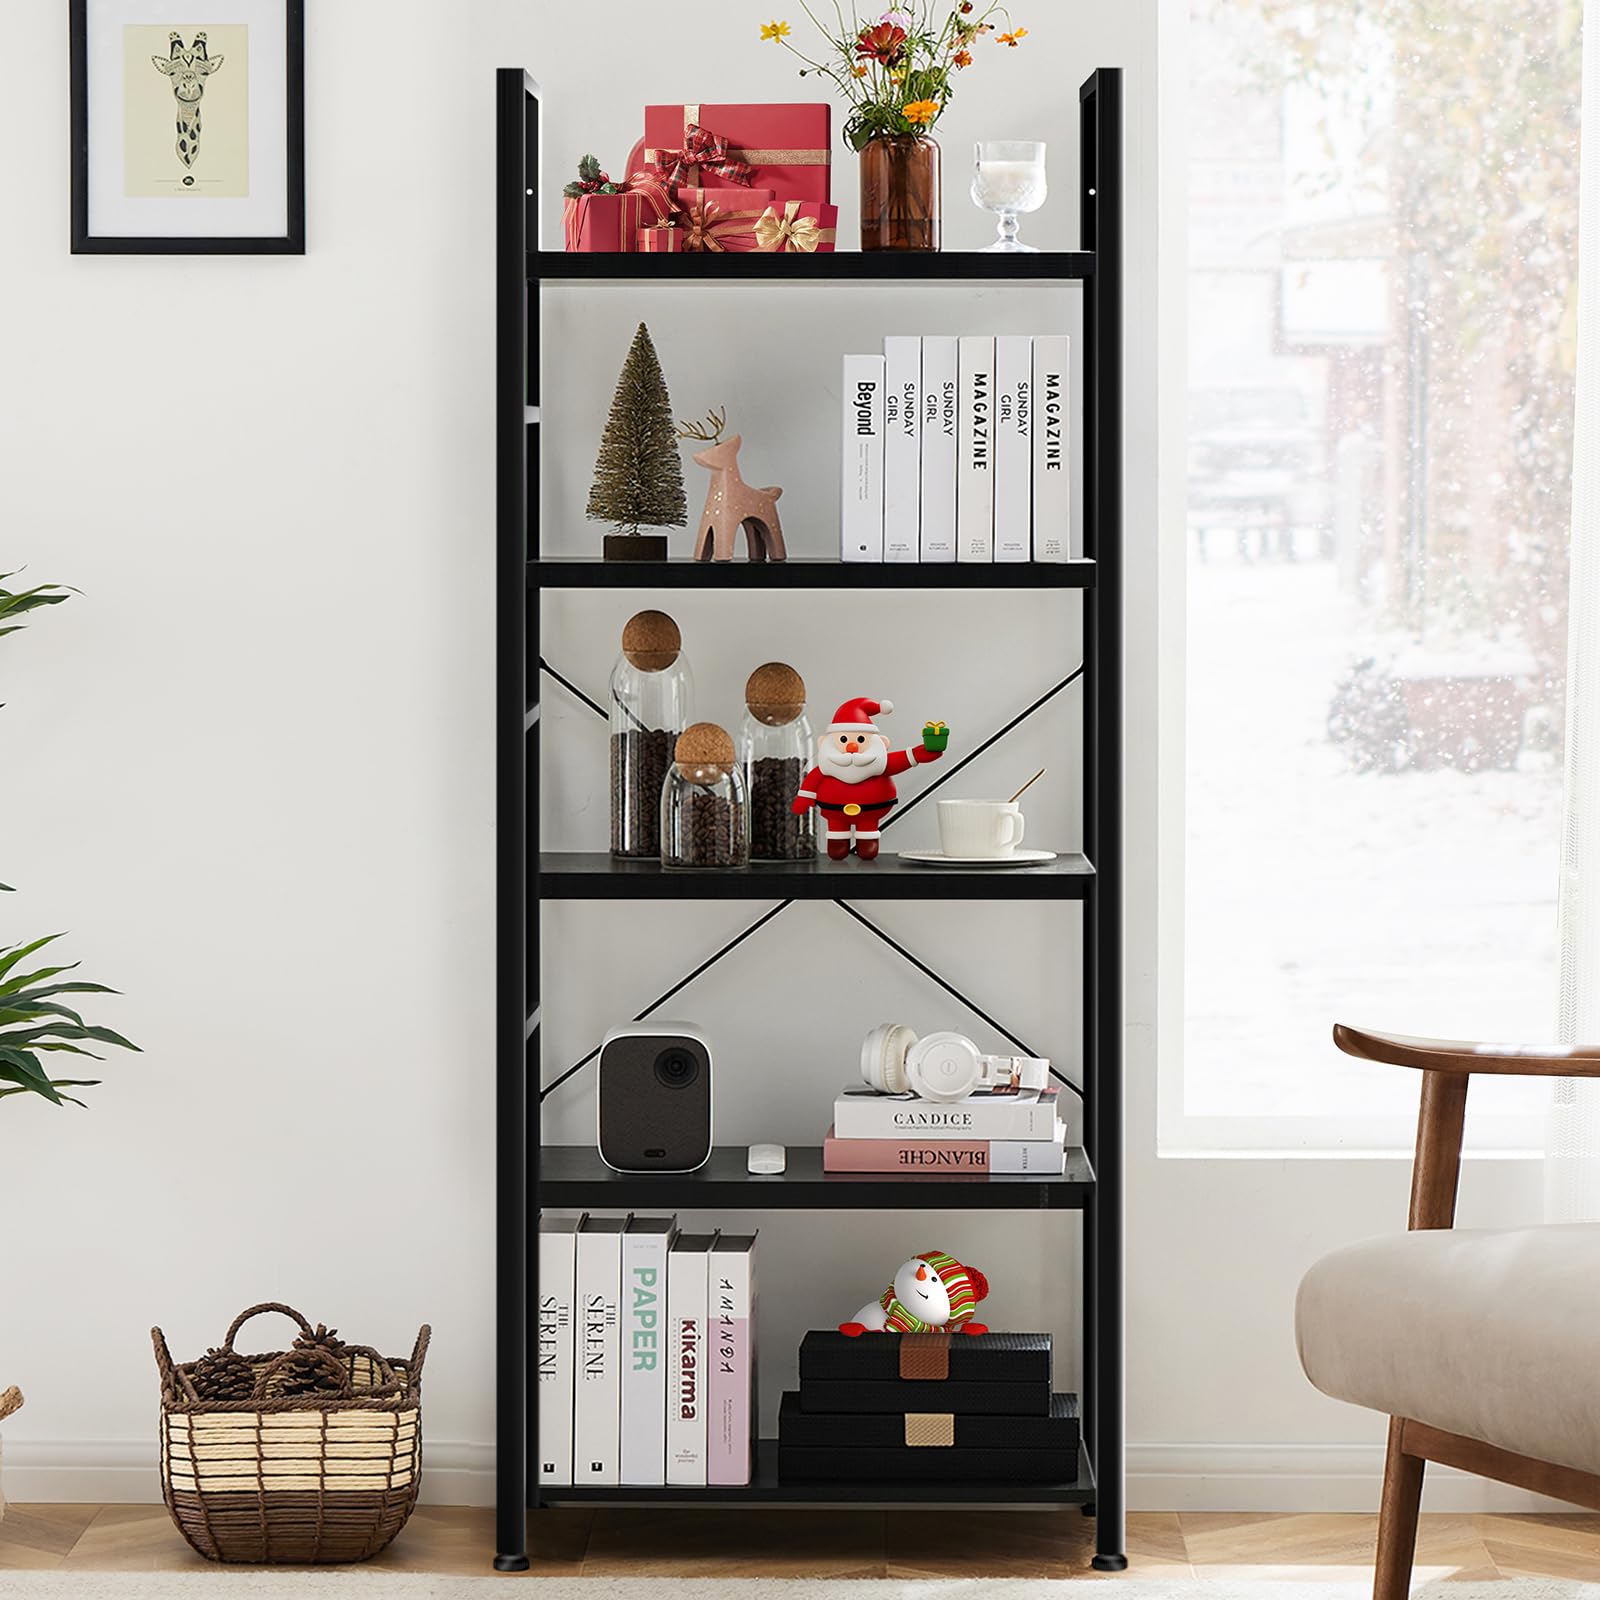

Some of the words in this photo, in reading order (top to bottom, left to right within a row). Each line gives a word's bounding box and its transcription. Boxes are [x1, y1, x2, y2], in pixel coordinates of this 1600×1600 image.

[853, 382, 876, 436] Beyond
[887, 395, 898, 425] GIRL
[903, 383, 915, 437] SUNDAY
[926, 394, 937, 424] GIRL
[943, 382, 954, 436] SUNDAY
[972, 373, 988, 470] MAGAZINE
[1000, 394, 1011, 424] GIRL
[1017, 382, 1029, 437] SUNDAY
[1045, 374, 1061, 471] MAGAZINE
[893, 1113, 973, 1125] CANDICE
[899, 1150, 986, 1165] BLANCHE
[540, 1295, 557, 1382] SERENE
[558, 1303, 569, 1329] THE
[586, 1294, 605, 1381] SERENE
[605, 1302, 616, 1328] THE
[633, 1267, 657, 1371] PAPER
[719, 1278, 735, 1374] AMANDA
